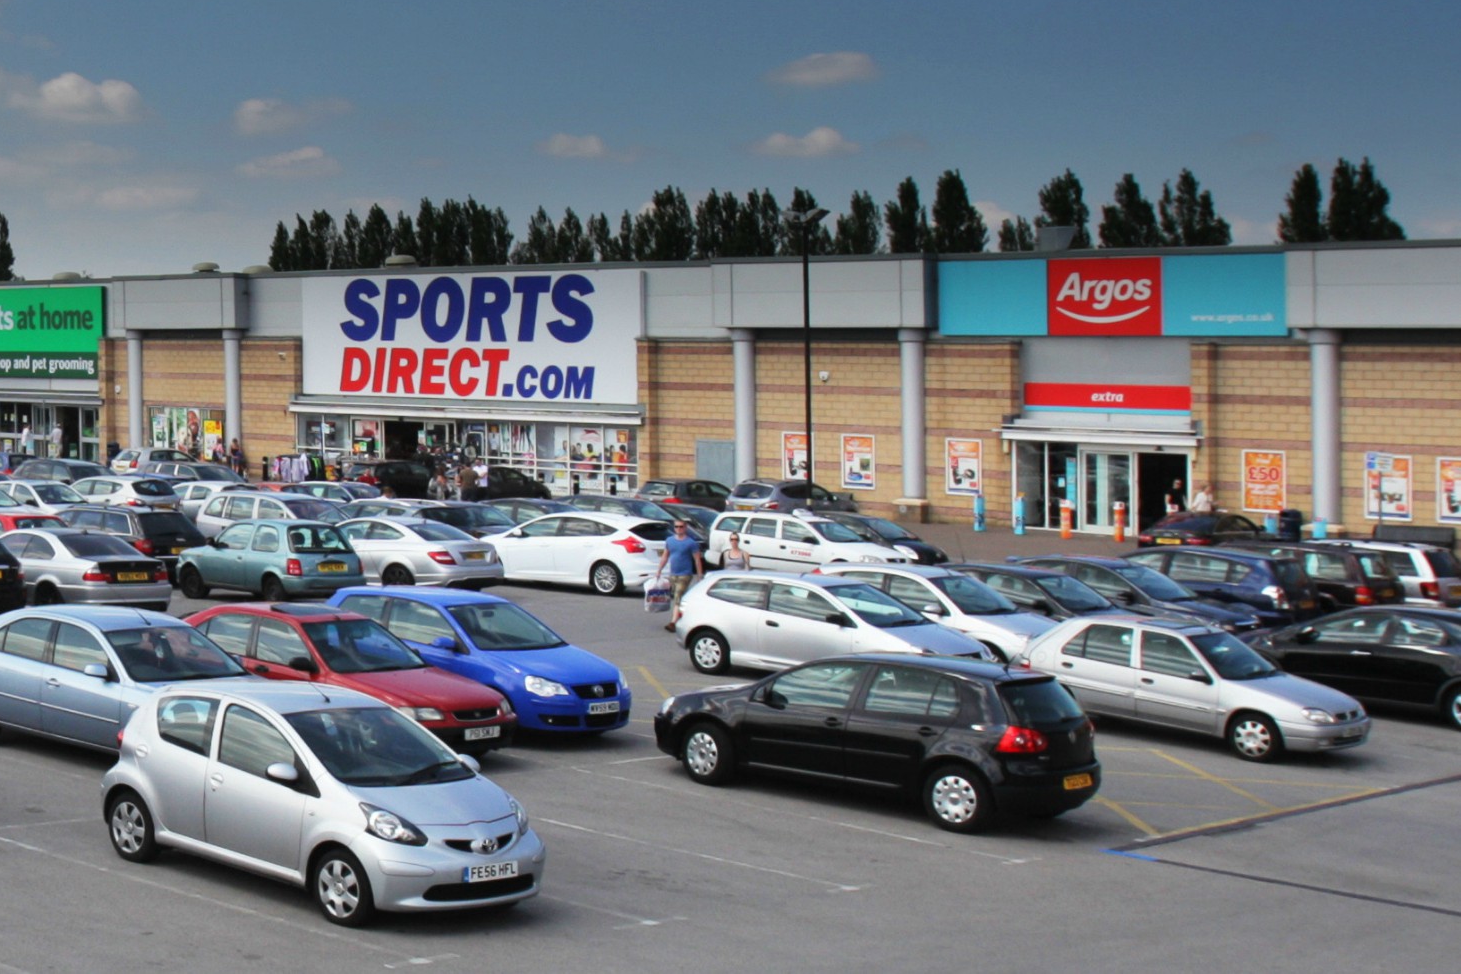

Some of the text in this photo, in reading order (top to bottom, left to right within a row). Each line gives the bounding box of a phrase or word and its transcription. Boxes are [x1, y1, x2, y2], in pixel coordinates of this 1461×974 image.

[1056, 272, 1152, 308] Argos
[17, 308, 35, 330] at
[39, 302, 94, 330] home
[340, 273, 595, 344] SPORTS
[13, 356, 29, 369] and
[32, 357, 46, 373] pet
[48, 357, 94, 374] grooming
[1091, 391, 1124, 402] extra
[1249, 467, 1280, 481] £50
[471, 862, 517, 880] FE56 HFL
